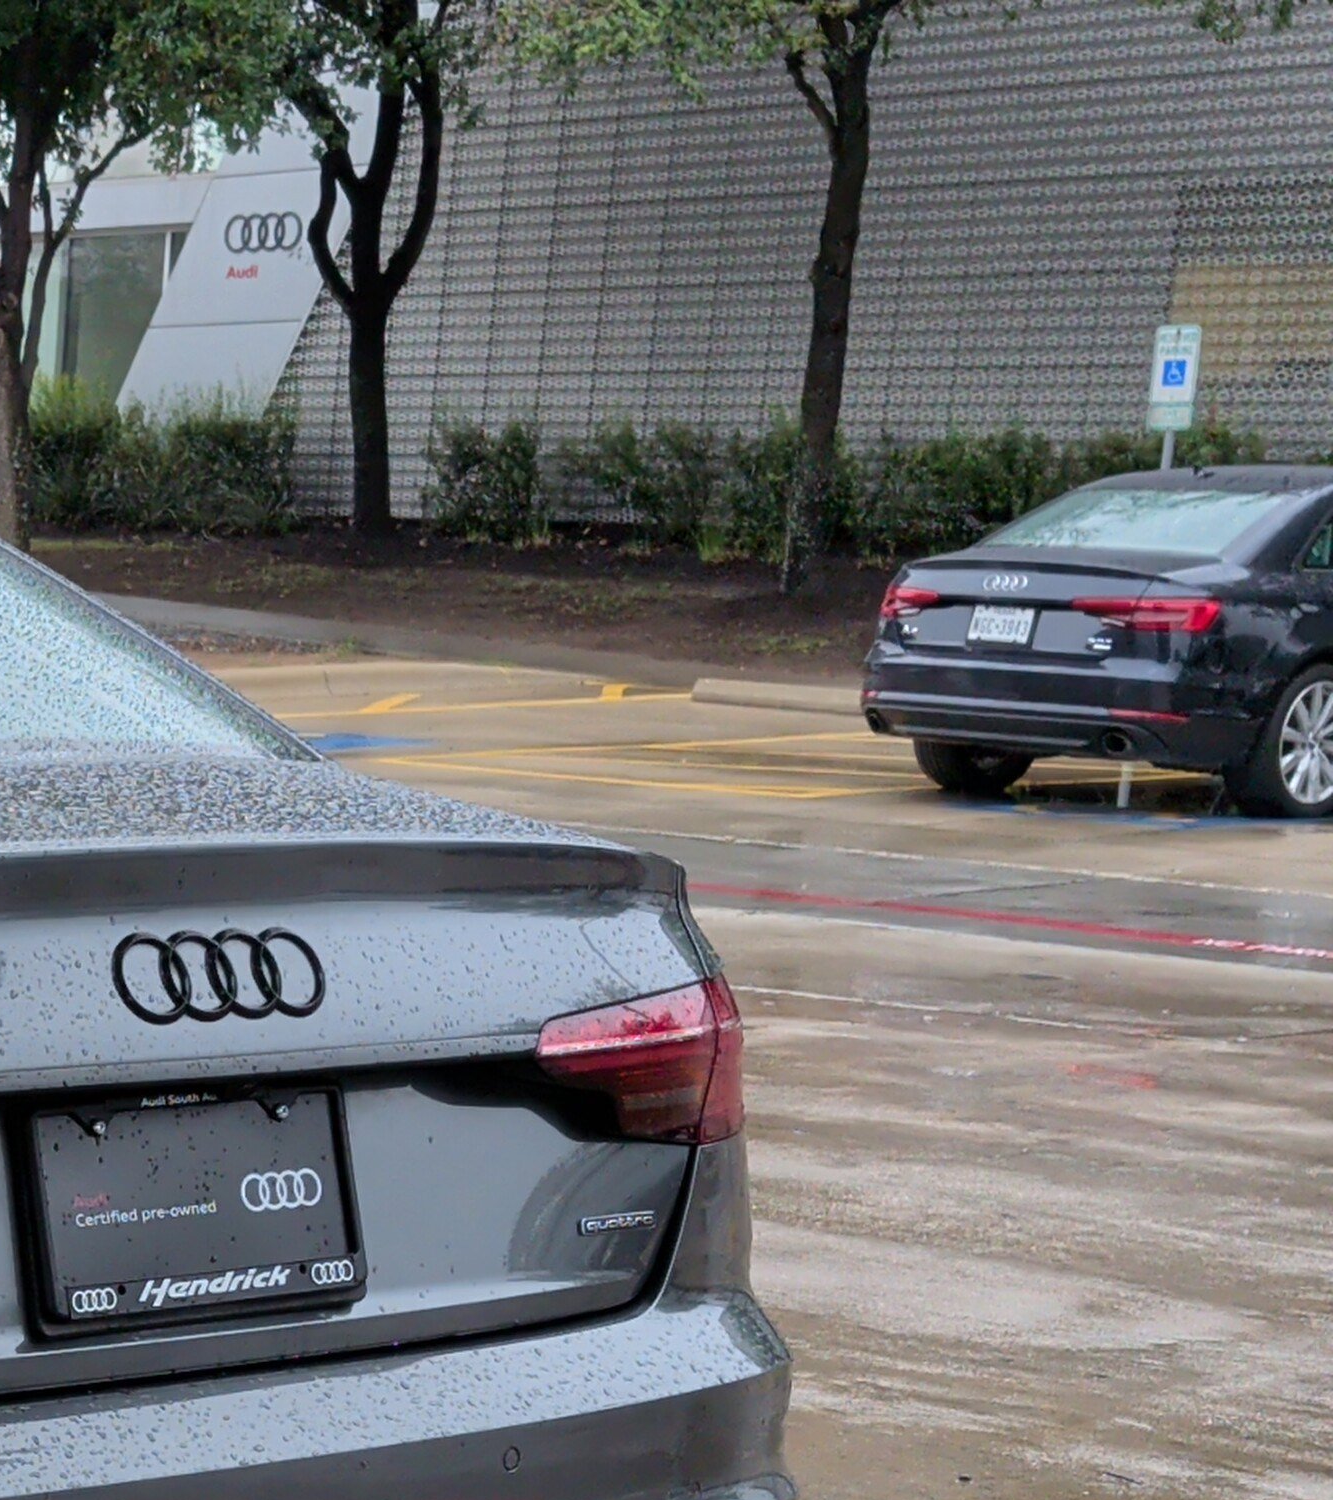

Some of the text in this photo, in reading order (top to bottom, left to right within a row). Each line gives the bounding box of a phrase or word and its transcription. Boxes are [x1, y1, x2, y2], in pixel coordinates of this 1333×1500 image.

[225, 264, 259, 279] Audi
[75, 1200, 217, 1228] Certified pre-owned
[138, 1264, 292, 1308] Hendrick
